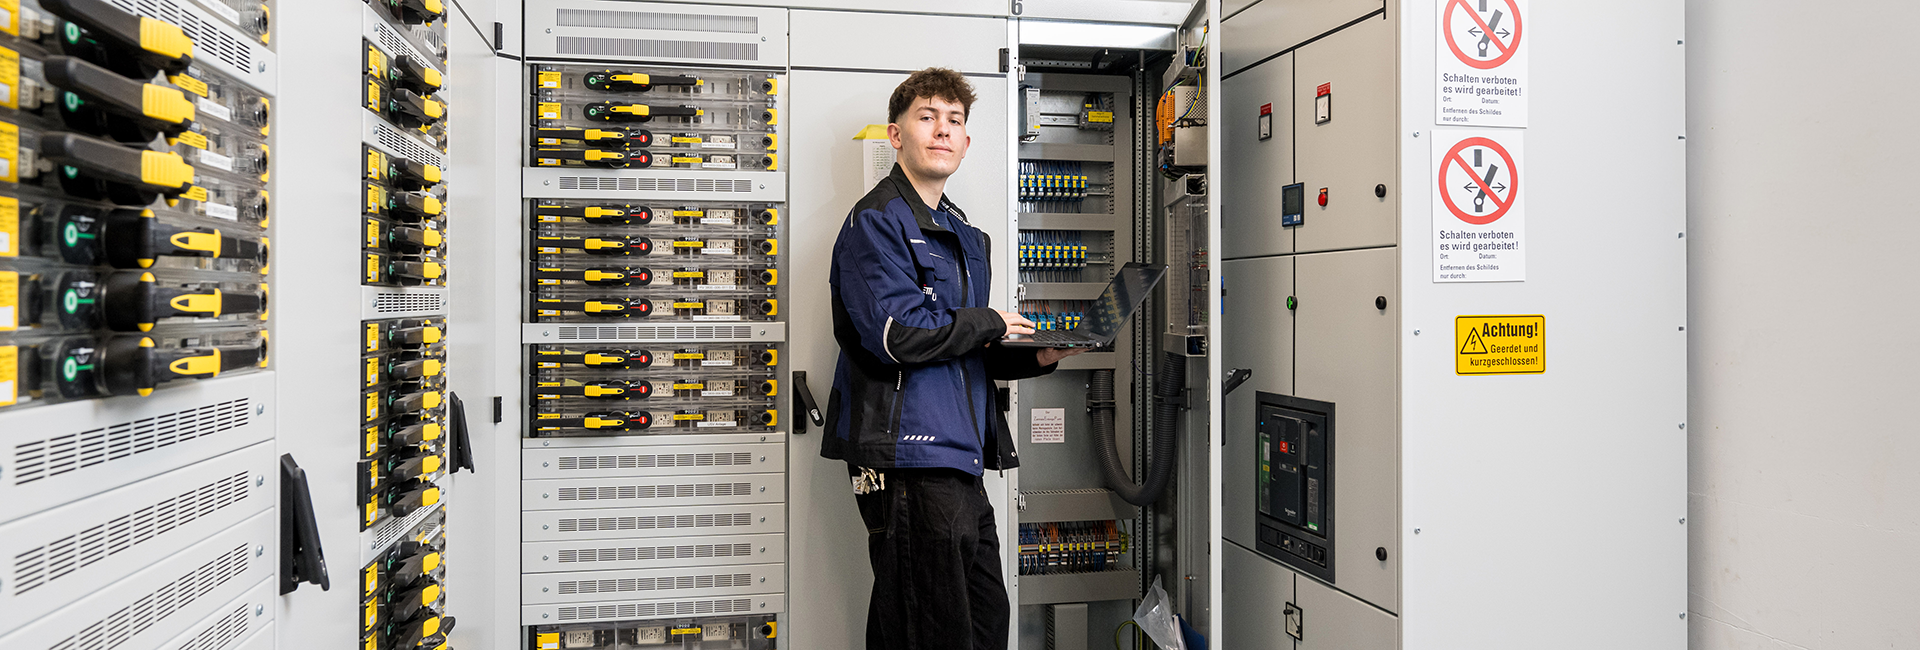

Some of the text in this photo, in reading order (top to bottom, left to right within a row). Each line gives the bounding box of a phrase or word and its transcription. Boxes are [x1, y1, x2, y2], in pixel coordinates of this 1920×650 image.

[1443, 73, 1517, 85] Schalten verboten
[1455, 85, 1474, 94] wird
[1476, 86, 1522, 97] gearbeitet!
[1440, 230, 1514, 239] Schalten verboten
[1452, 241, 1471, 250] wird
[1473, 241, 1519, 252] gearbeitet!
[1482, 322, 1538, 338] Achtung!
[1490, 344, 1538, 353] Geerdet und
[1470, 356, 1538, 368] kurzgeschlossen!
